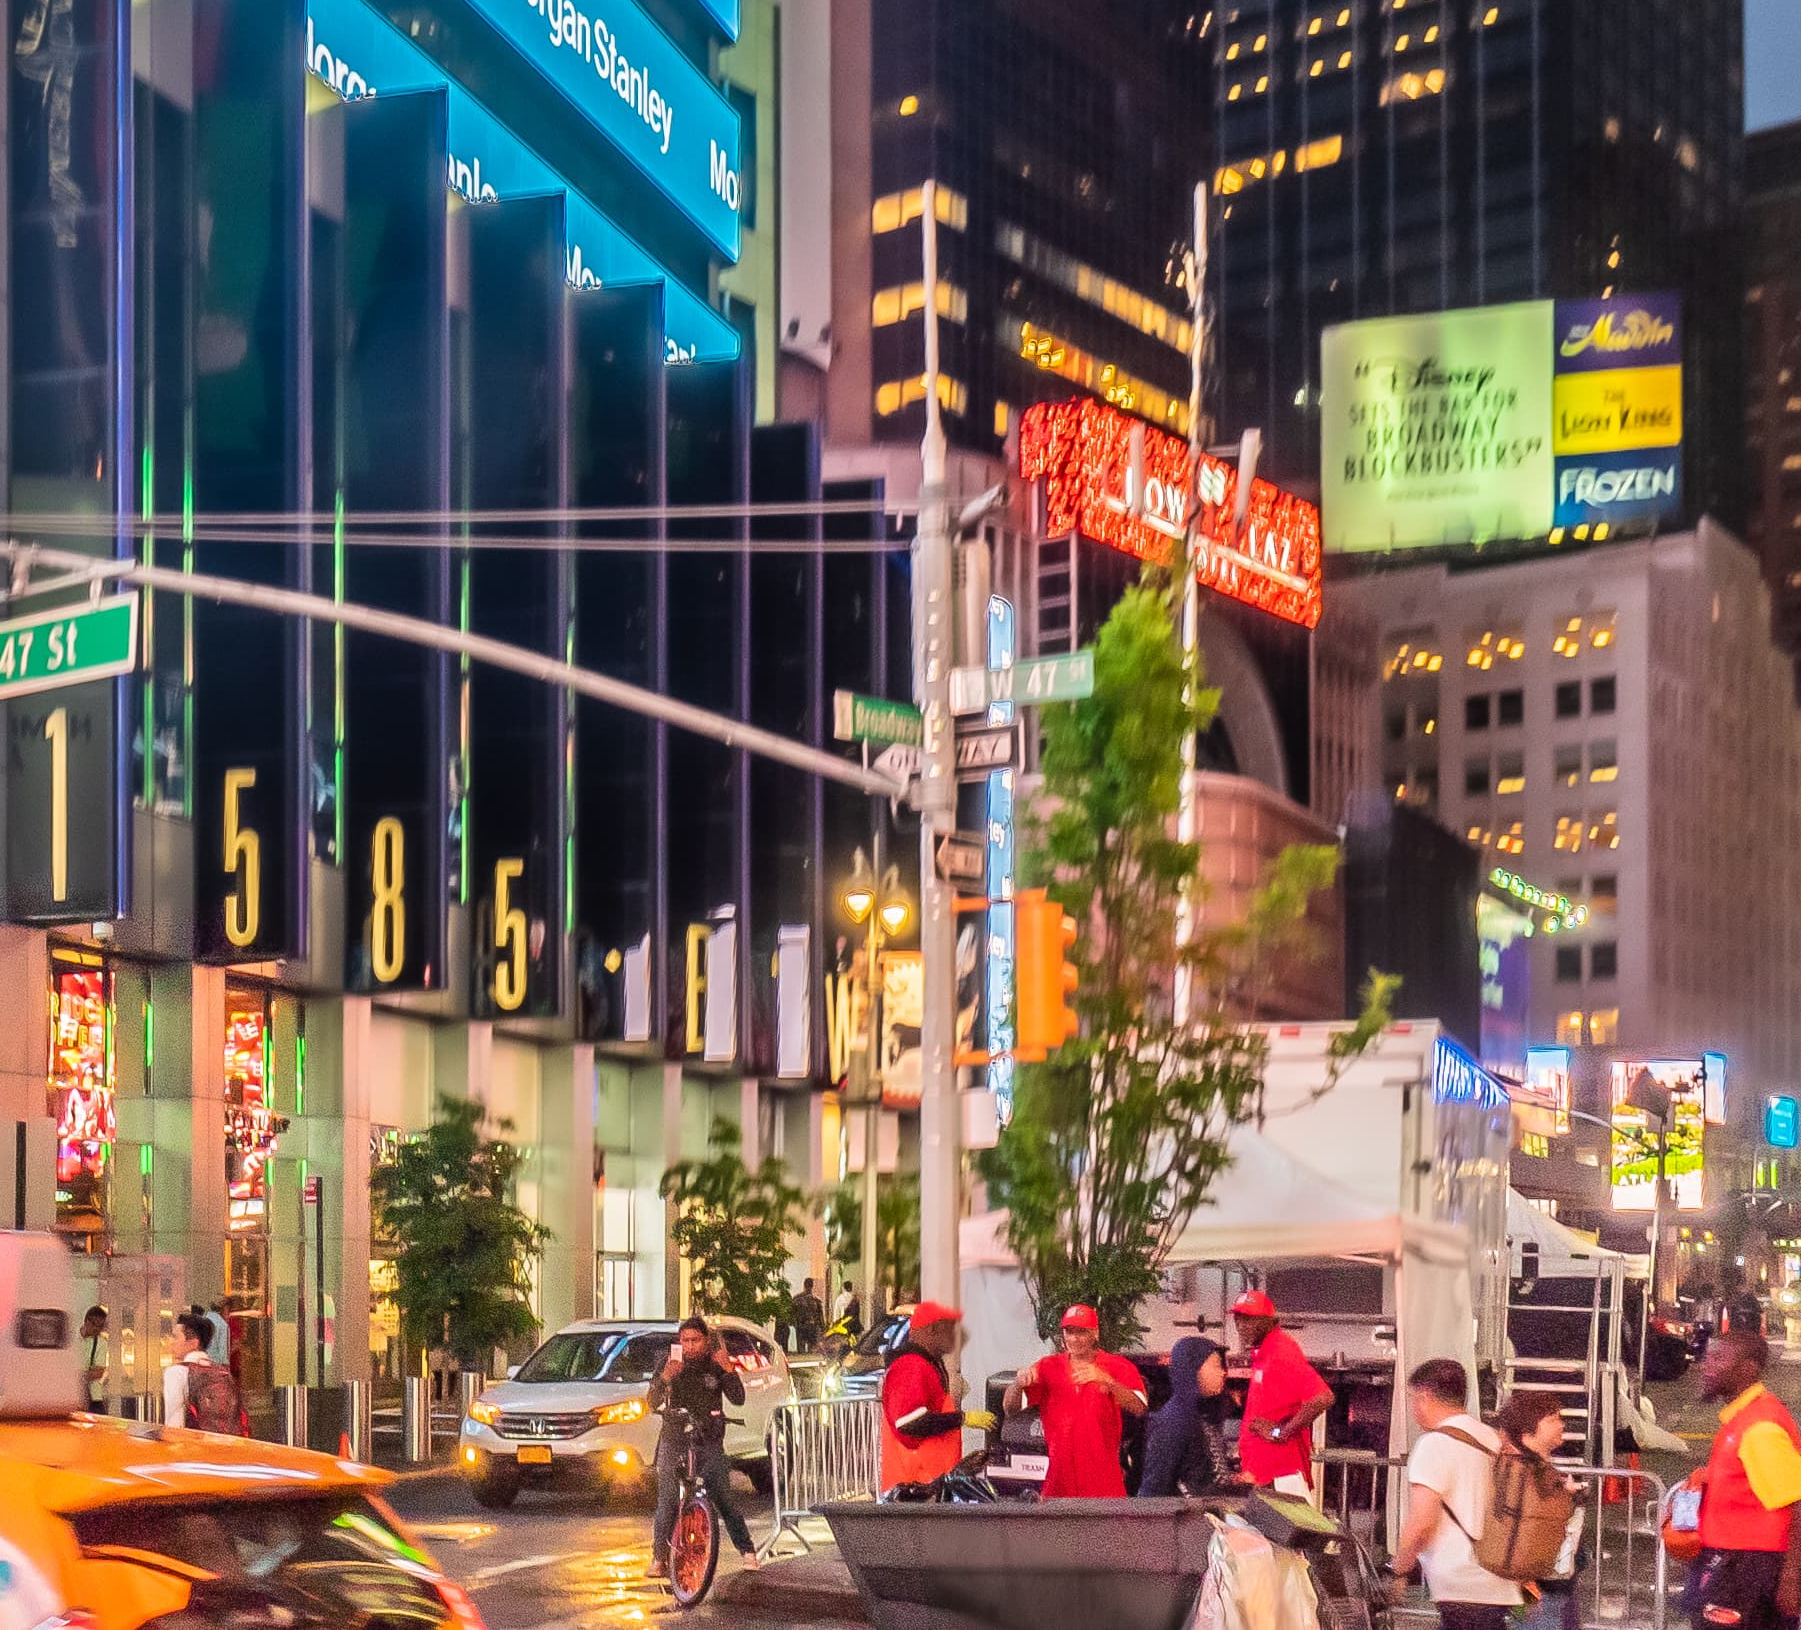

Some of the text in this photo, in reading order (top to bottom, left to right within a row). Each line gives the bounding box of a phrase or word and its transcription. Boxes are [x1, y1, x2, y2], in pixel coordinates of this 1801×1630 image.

[594, 19, 673, 154] Stanley
[1367, 413, 1502, 453] BROADWAY
[1560, 465, 1675, 508] FROZEN
[47, 620, 77, 671] St
[991, 668, 1015, 700] W
[1027, 660, 1057, 697] 47
